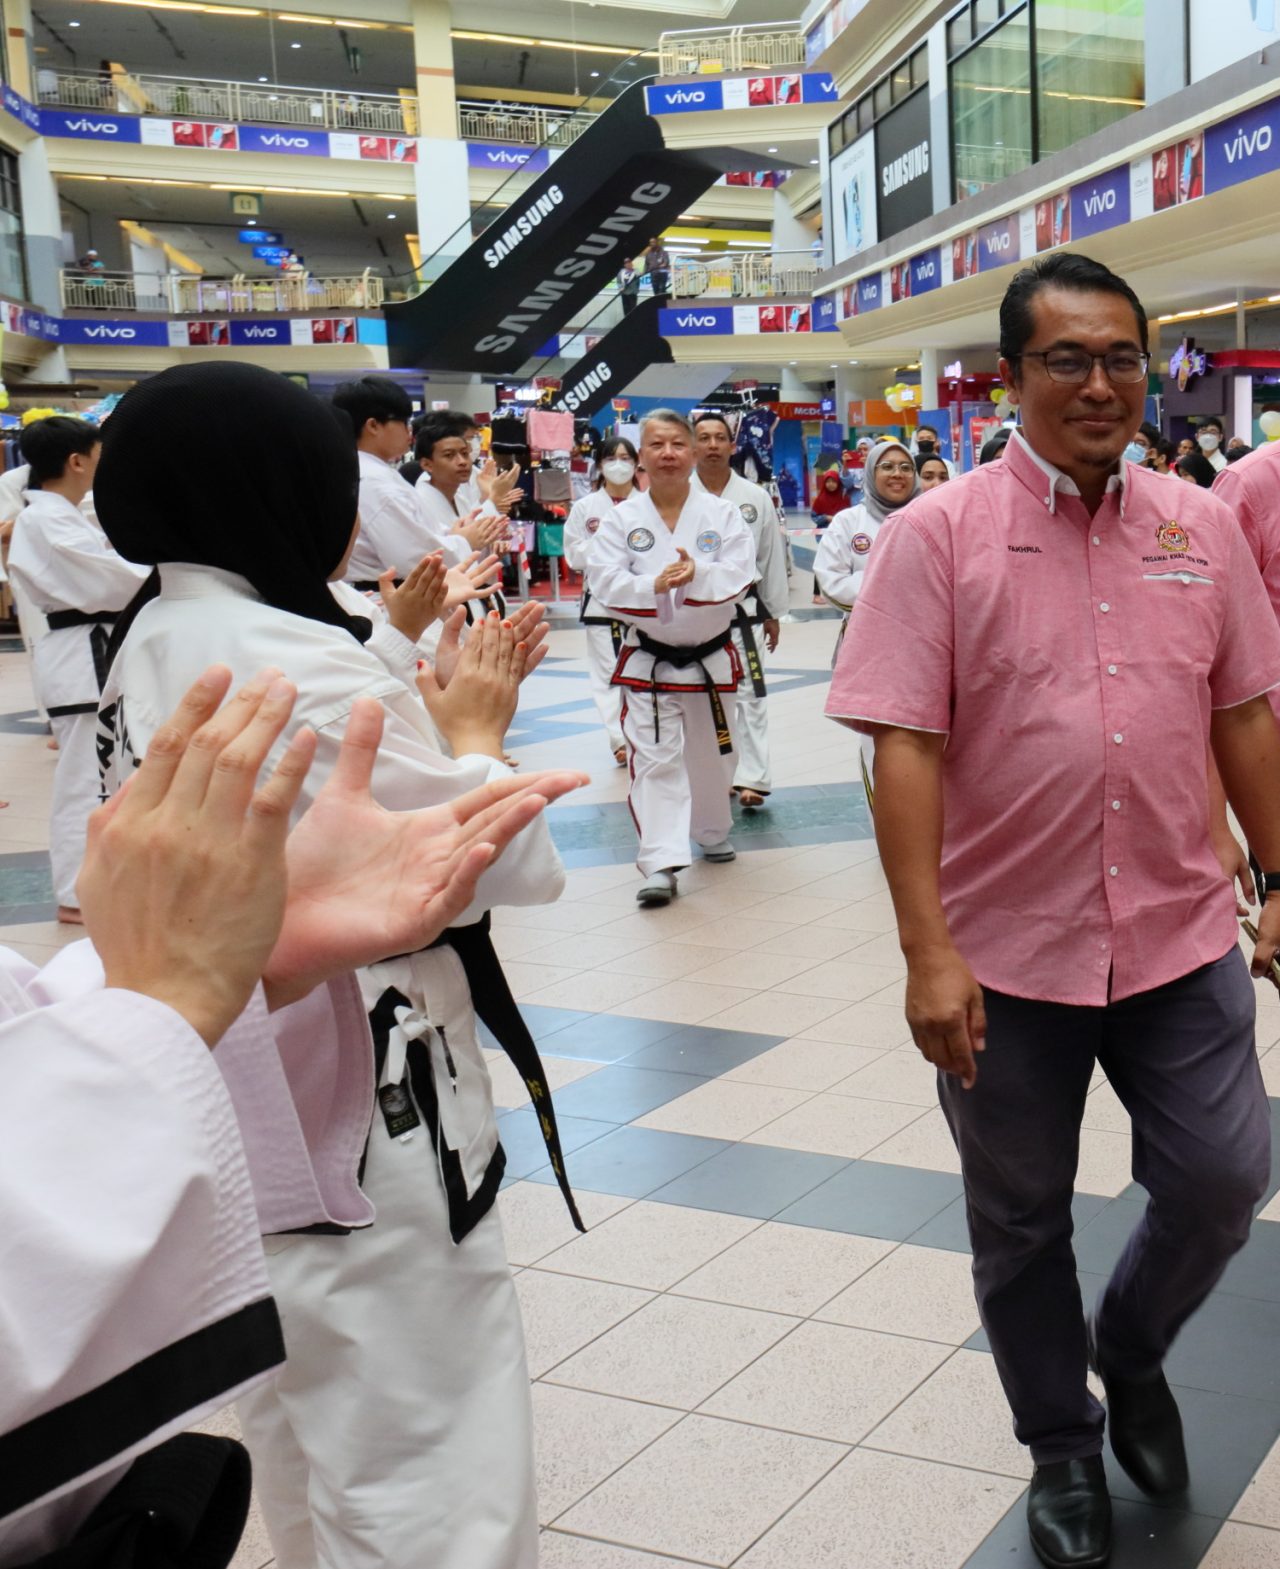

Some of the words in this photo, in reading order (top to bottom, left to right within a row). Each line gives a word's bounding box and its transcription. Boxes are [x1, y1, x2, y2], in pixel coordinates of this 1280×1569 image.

[665, 89, 706, 105] vivo
[65, 117, 118, 135] vivo
[260, 133, 309, 149] vivo
[1223, 125, 1272, 164] vivo
[487, 150, 531, 165] vivo
[882, 140, 929, 198] SAMSUNG
[1083, 188, 1116, 218] vivo
[483, 184, 565, 270] SAMSUNG
[986, 230, 1010, 255] vivo
[474, 180, 673, 355] SAMSUNG
[916, 260, 936, 281] vivo
[862, 283, 878, 301] vivo
[675, 313, 717, 328] vivo
[84, 325, 137, 339] vivo
[243, 324, 278, 339] vivo
